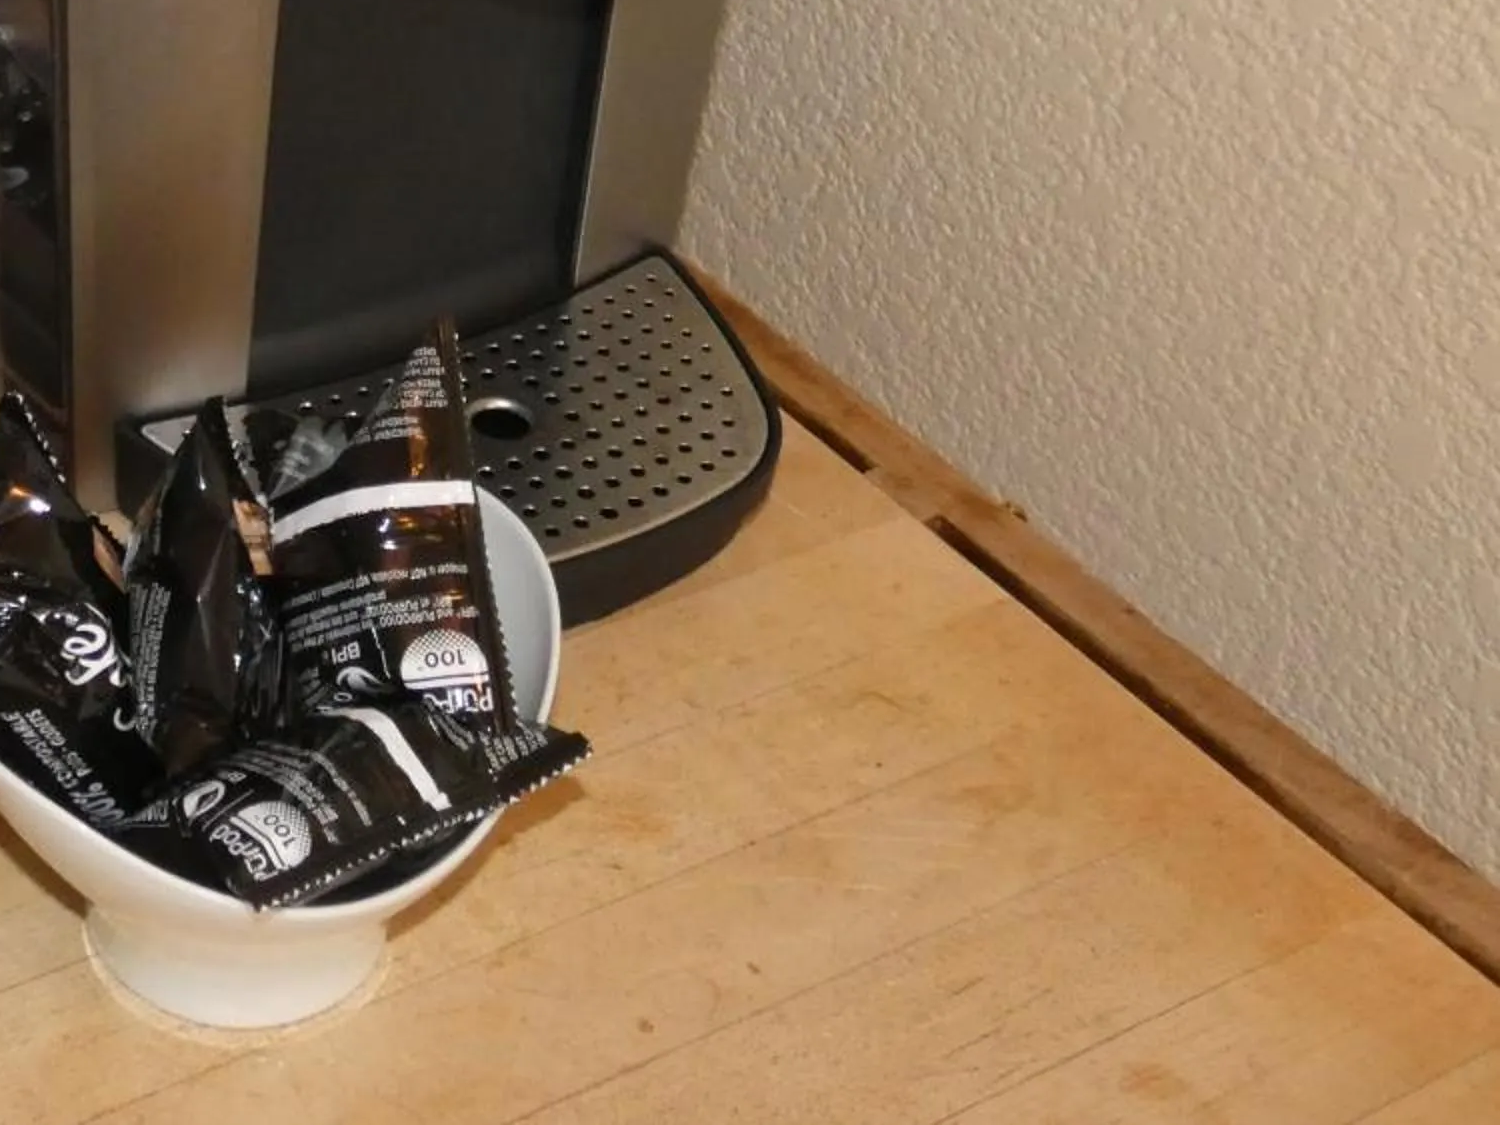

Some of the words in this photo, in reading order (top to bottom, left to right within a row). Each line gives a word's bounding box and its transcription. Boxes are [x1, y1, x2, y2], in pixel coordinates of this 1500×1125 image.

[330, 641, 361, 664] BPI
[422, 648, 466, 670] 100
[263, 813, 297, 848] 100
